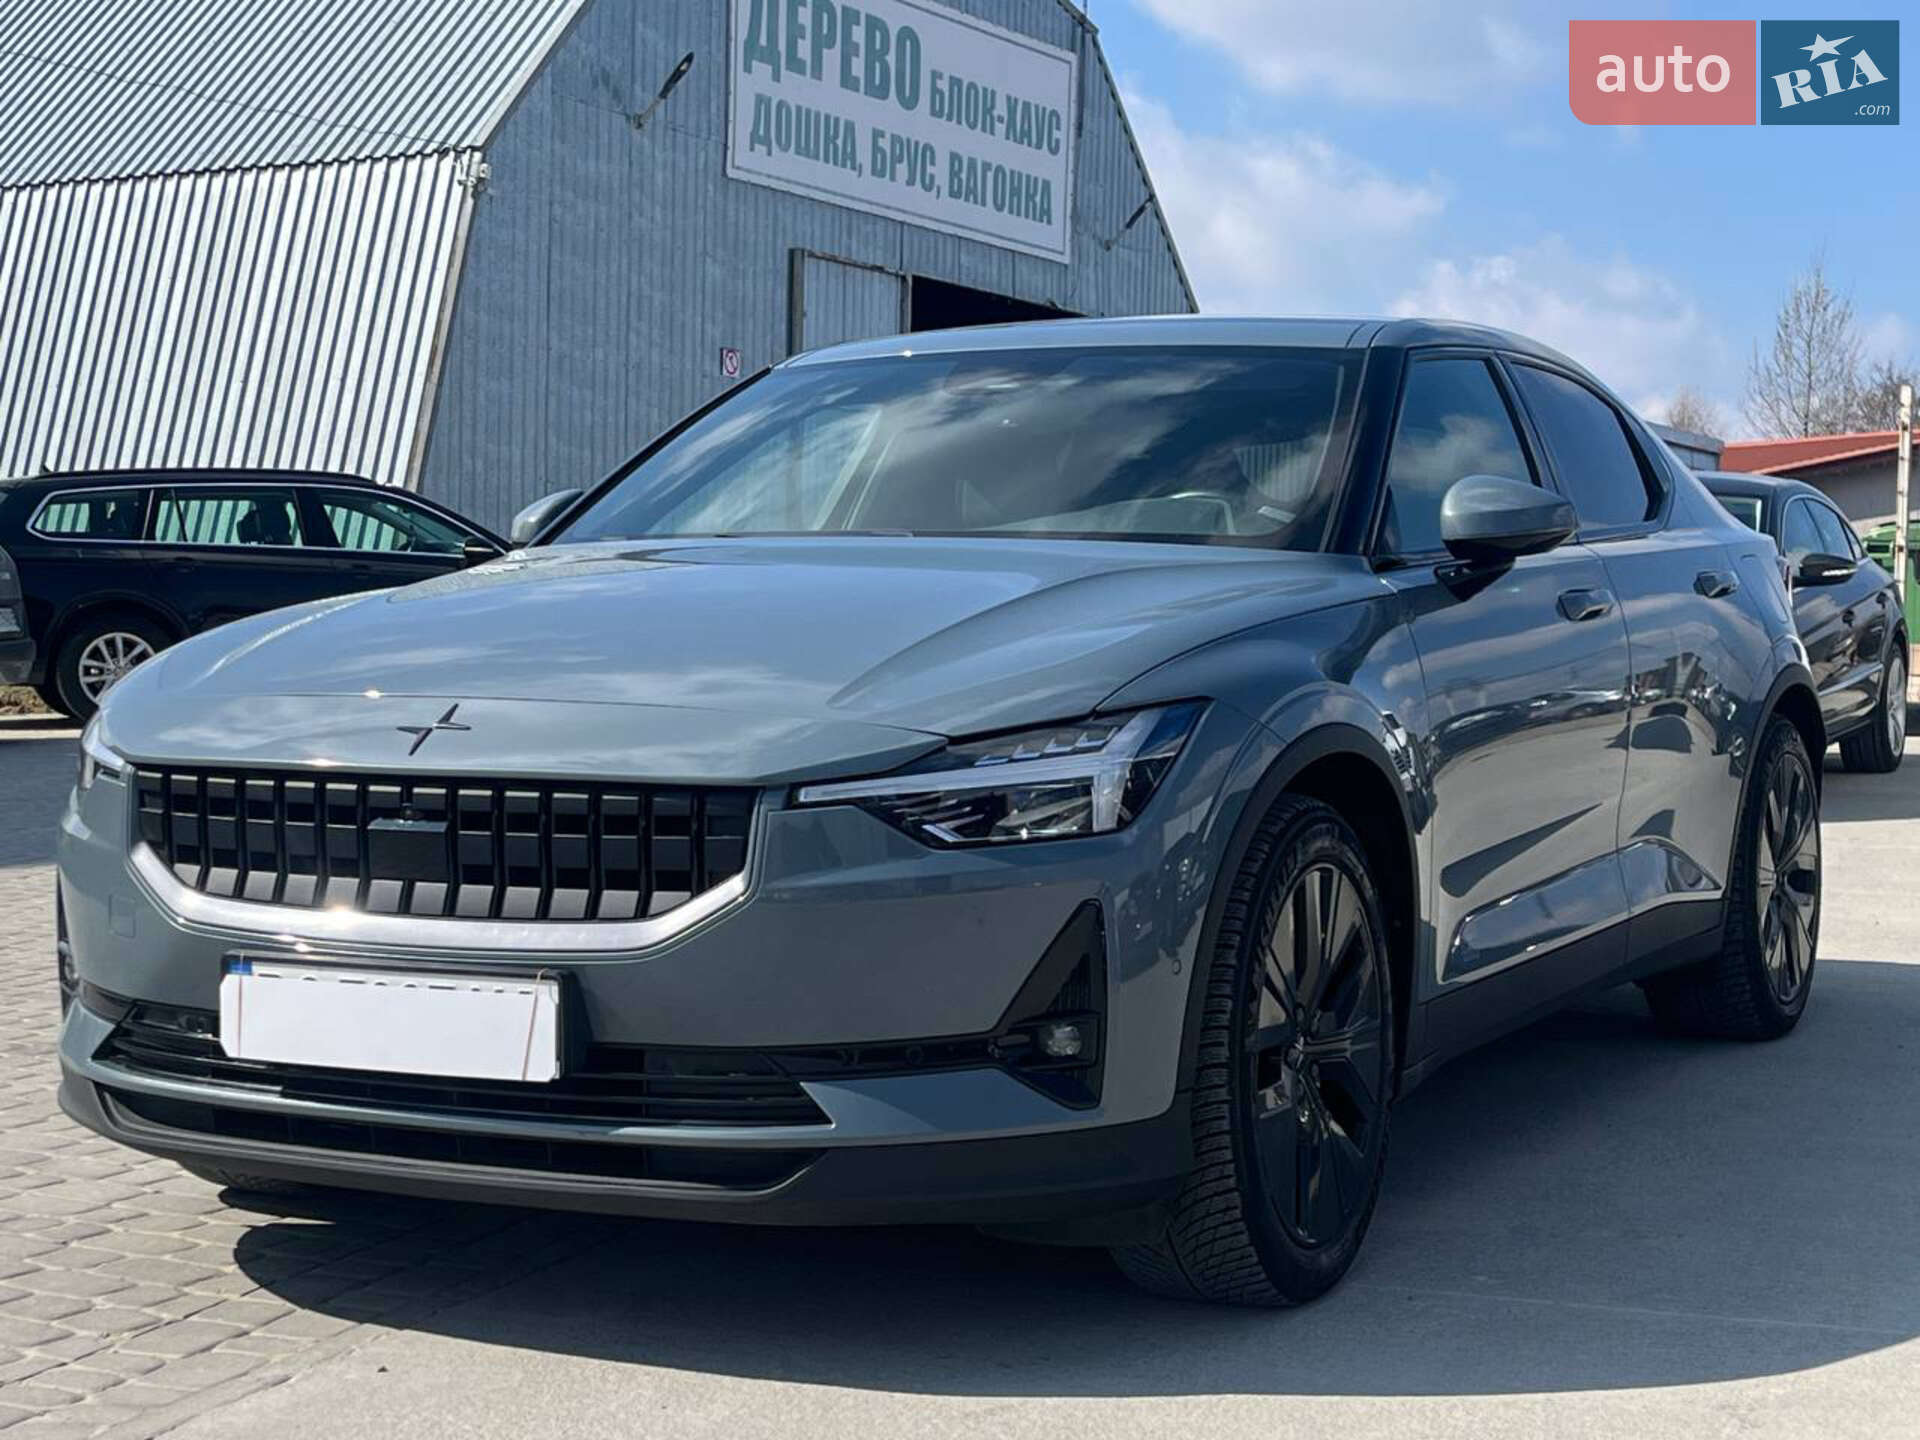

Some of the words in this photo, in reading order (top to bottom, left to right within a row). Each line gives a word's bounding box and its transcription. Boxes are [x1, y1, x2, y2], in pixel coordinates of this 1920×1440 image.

[743, 0, 922, 111] ДЕРЕВО
[929, 69, 1062, 156] БЛОК-ХАУС
[749, 93, 863, 179] ДОШКА,
[870, 126, 941, 200] БРУС,
[948, 151, 1053, 226] ВАГОНКА
